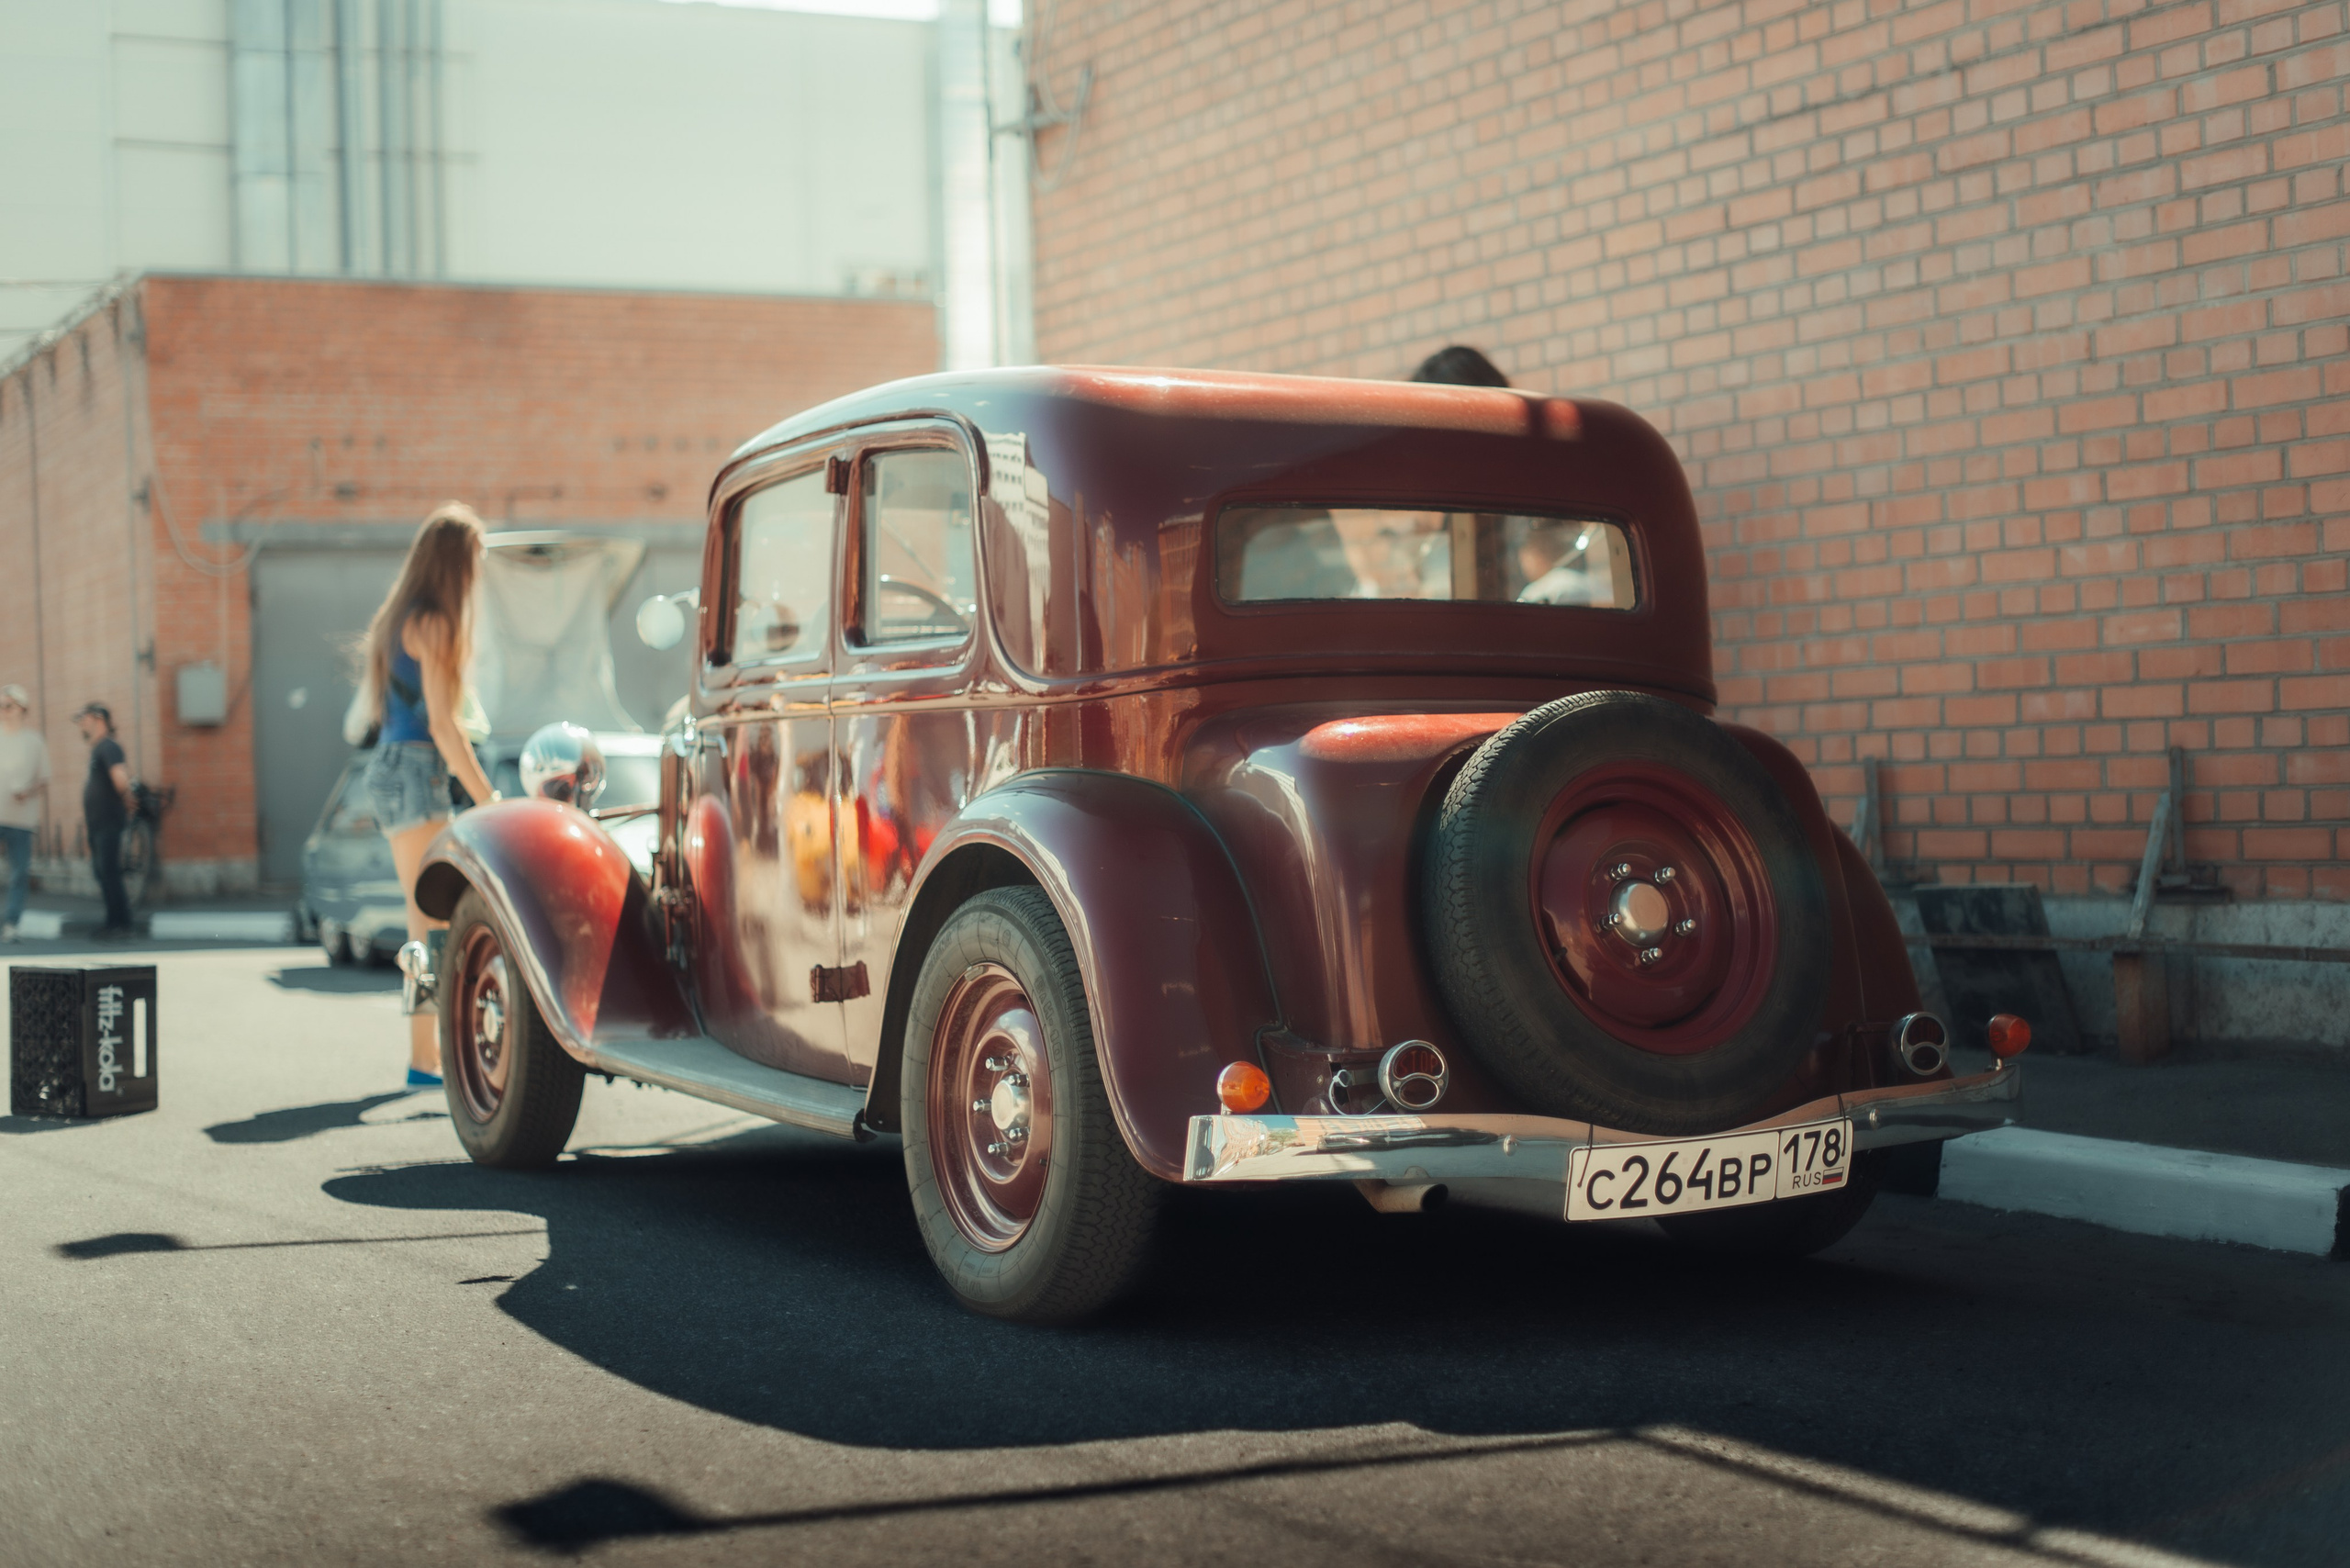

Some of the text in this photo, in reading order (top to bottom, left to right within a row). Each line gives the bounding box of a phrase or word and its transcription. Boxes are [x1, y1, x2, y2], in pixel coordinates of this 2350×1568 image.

[1400, 1049, 1438, 1075] STOP
[1783, 1127, 1841, 1174] 178
[1792, 1171, 1822, 1190] RUS
